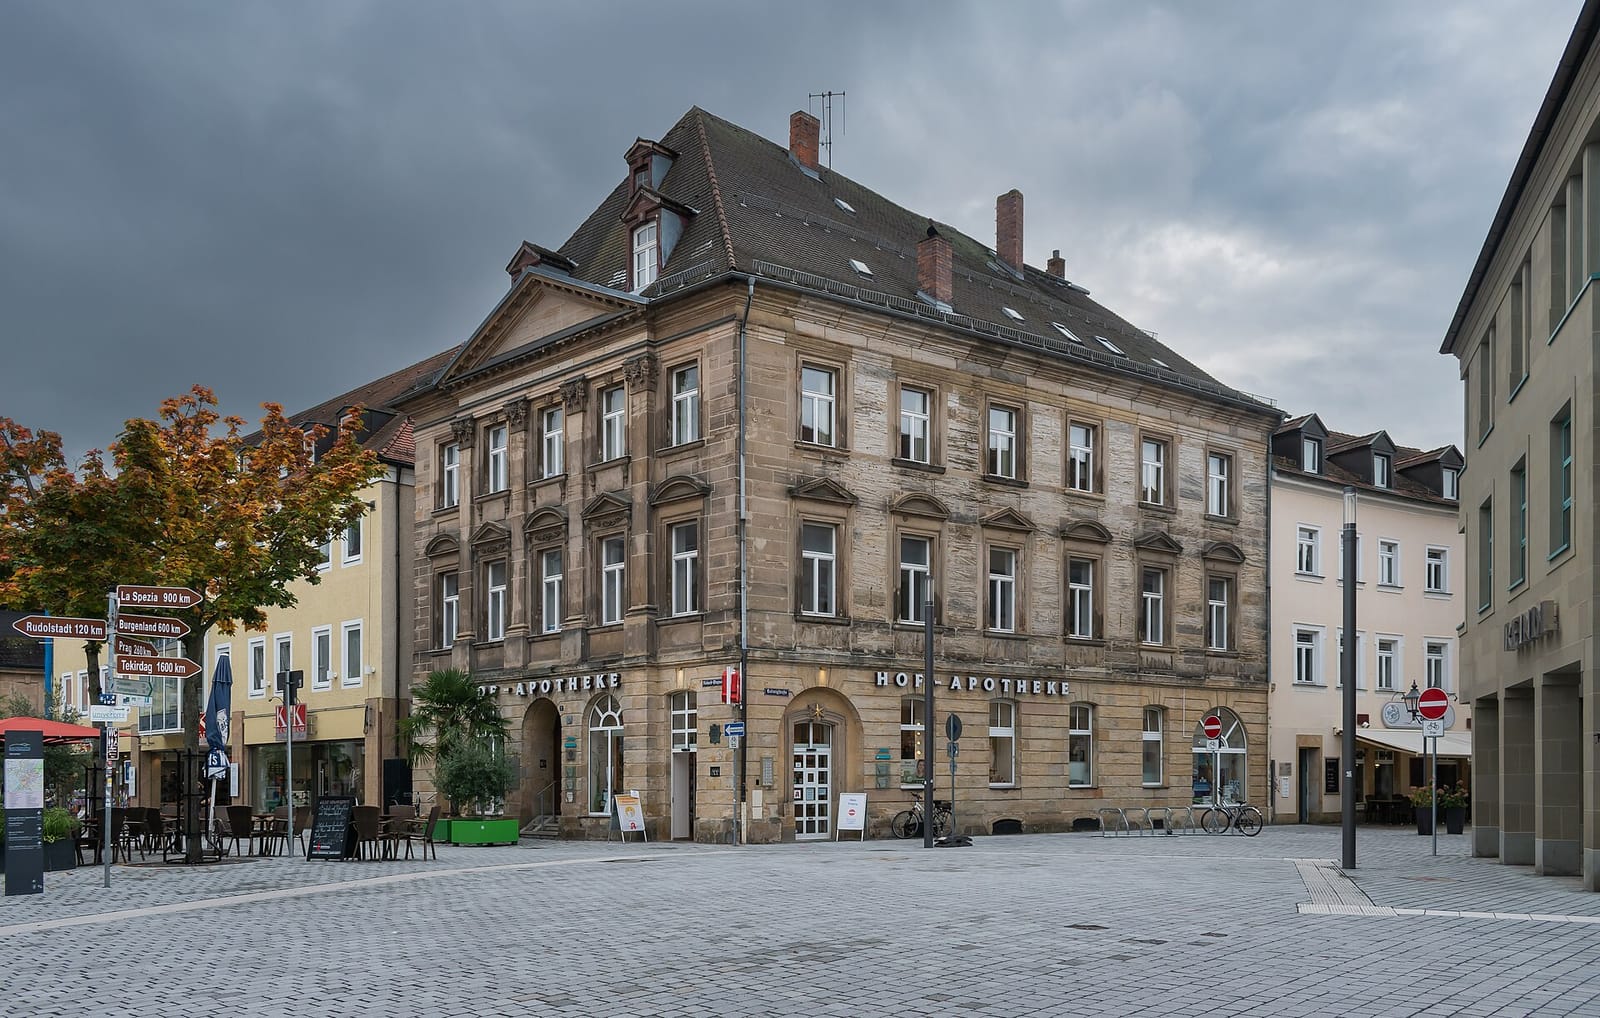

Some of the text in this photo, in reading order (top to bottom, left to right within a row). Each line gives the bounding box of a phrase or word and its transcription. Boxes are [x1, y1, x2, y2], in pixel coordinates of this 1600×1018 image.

[121, 591, 190, 603] La Spezia 900 km
[26, 622, 102, 635] Rudolstadt 120 km
[119, 620, 180, 633] Burgenland 600 km
[119, 641, 132, 654] Prag
[121, 660, 185, 674] Tekirdag 1600 km
